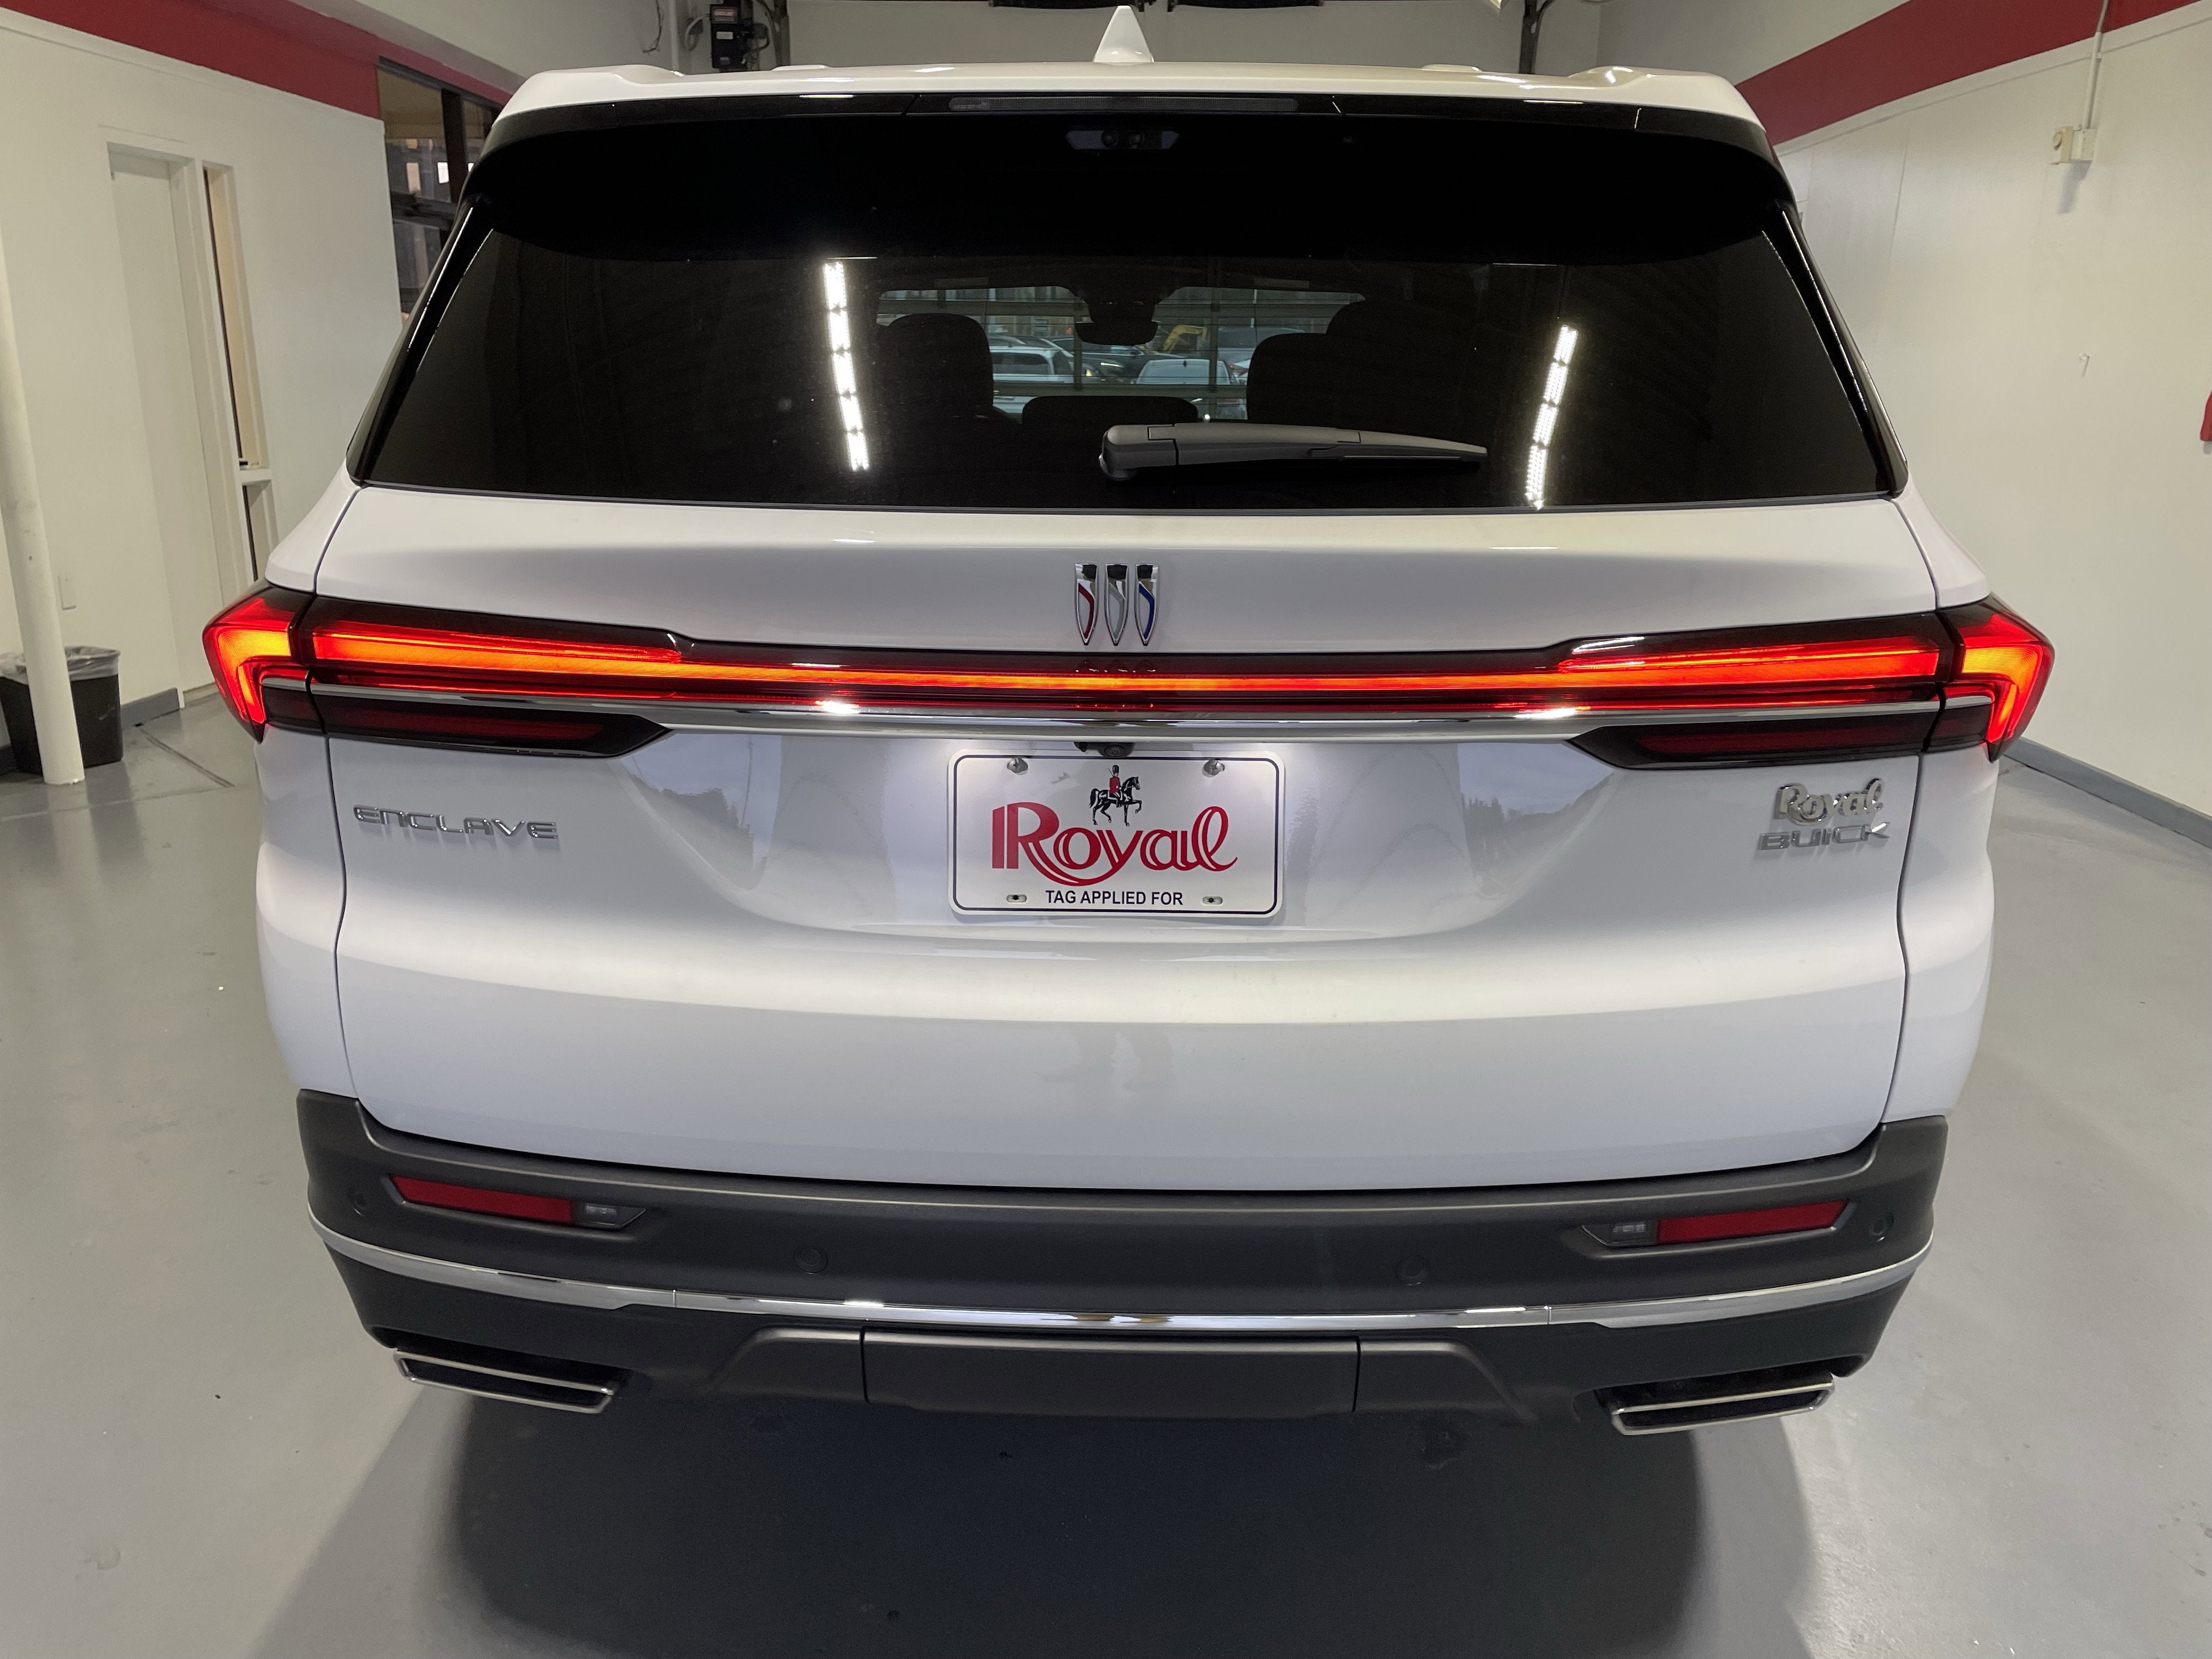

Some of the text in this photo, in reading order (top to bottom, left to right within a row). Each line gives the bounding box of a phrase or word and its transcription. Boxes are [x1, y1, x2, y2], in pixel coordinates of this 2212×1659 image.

[1773, 778, 1884, 826] Royal
[353, 804, 558, 839] ENCLAVE
[1757, 822, 1891, 850] BUICK
[992, 802, 1238, 887] Royal
[1045, 890, 1183, 906] TAG APPLIED FOR
